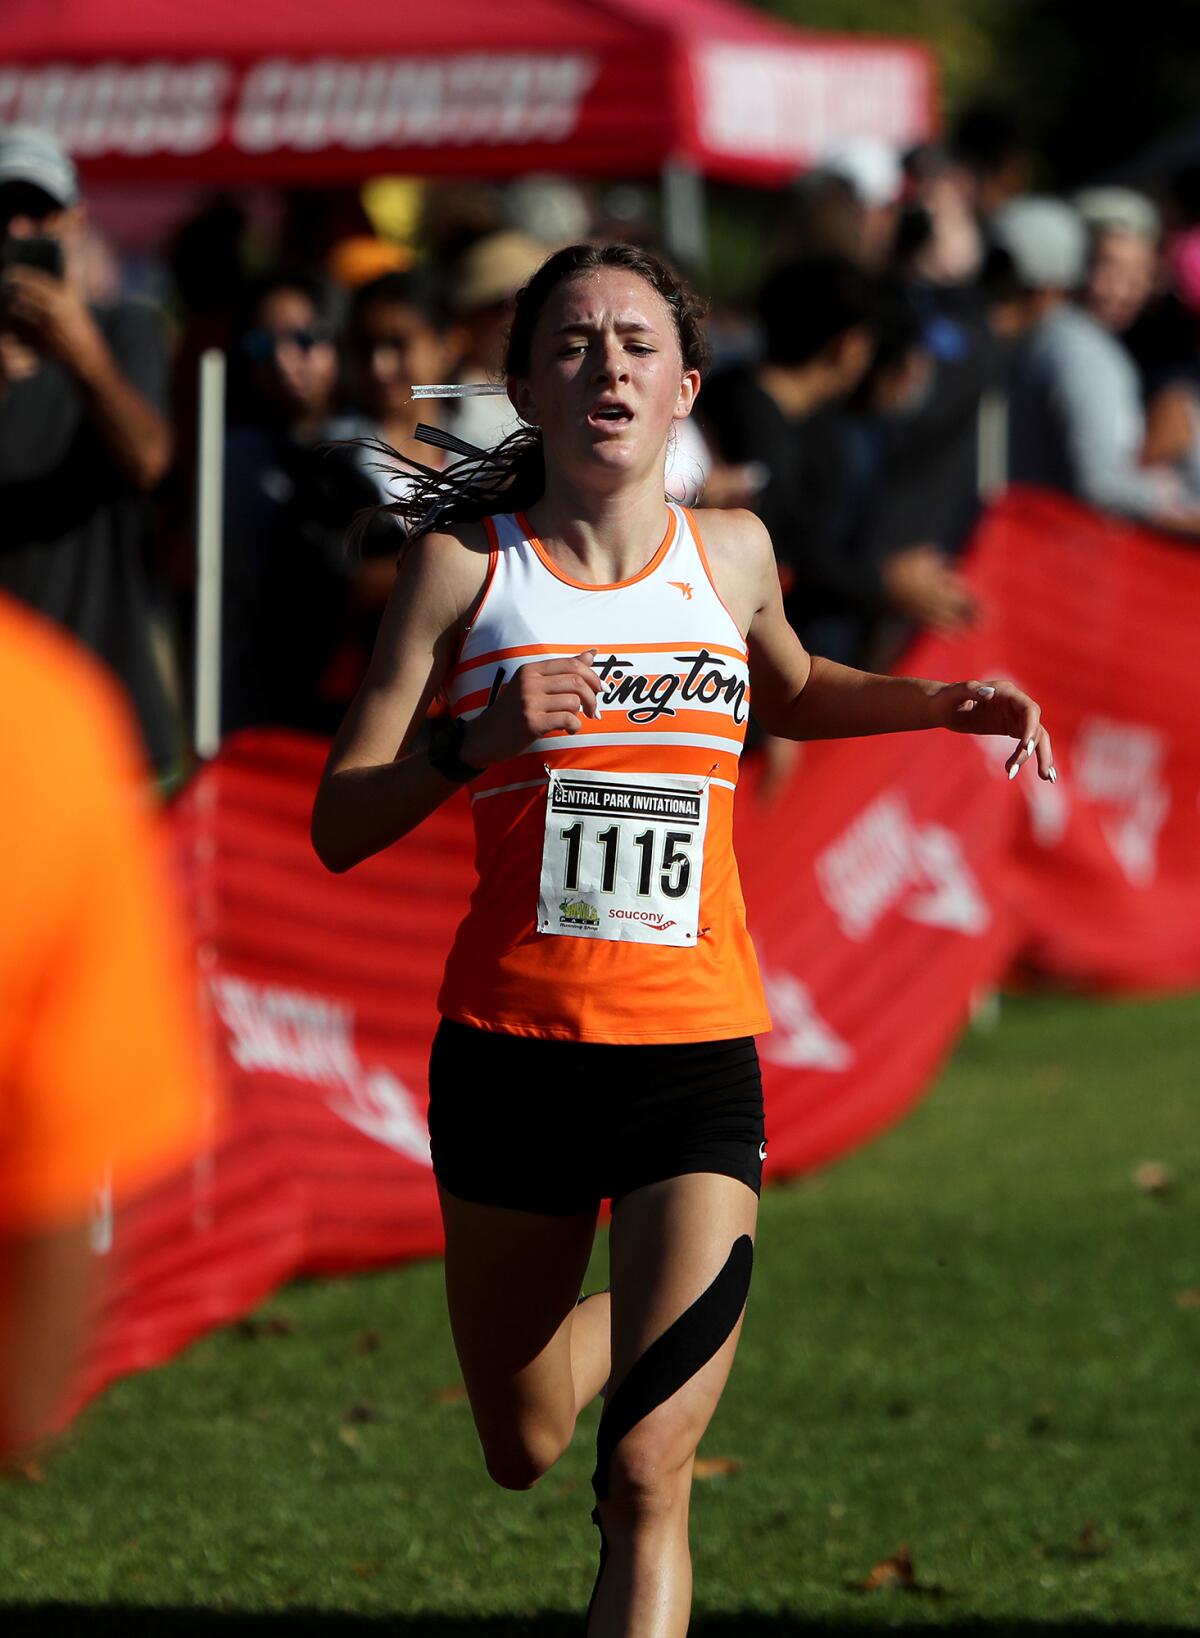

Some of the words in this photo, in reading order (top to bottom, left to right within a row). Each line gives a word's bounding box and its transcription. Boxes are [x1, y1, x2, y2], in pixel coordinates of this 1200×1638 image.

[488, 649, 747, 724] tington
[555, 788, 600, 806] CENTRAL
[603, 793, 631, 808] PARK
[632, 796, 698, 815] INVITATIONAL
[560, 821, 693, 899] 1115
[608, 908, 664, 923] saucony
